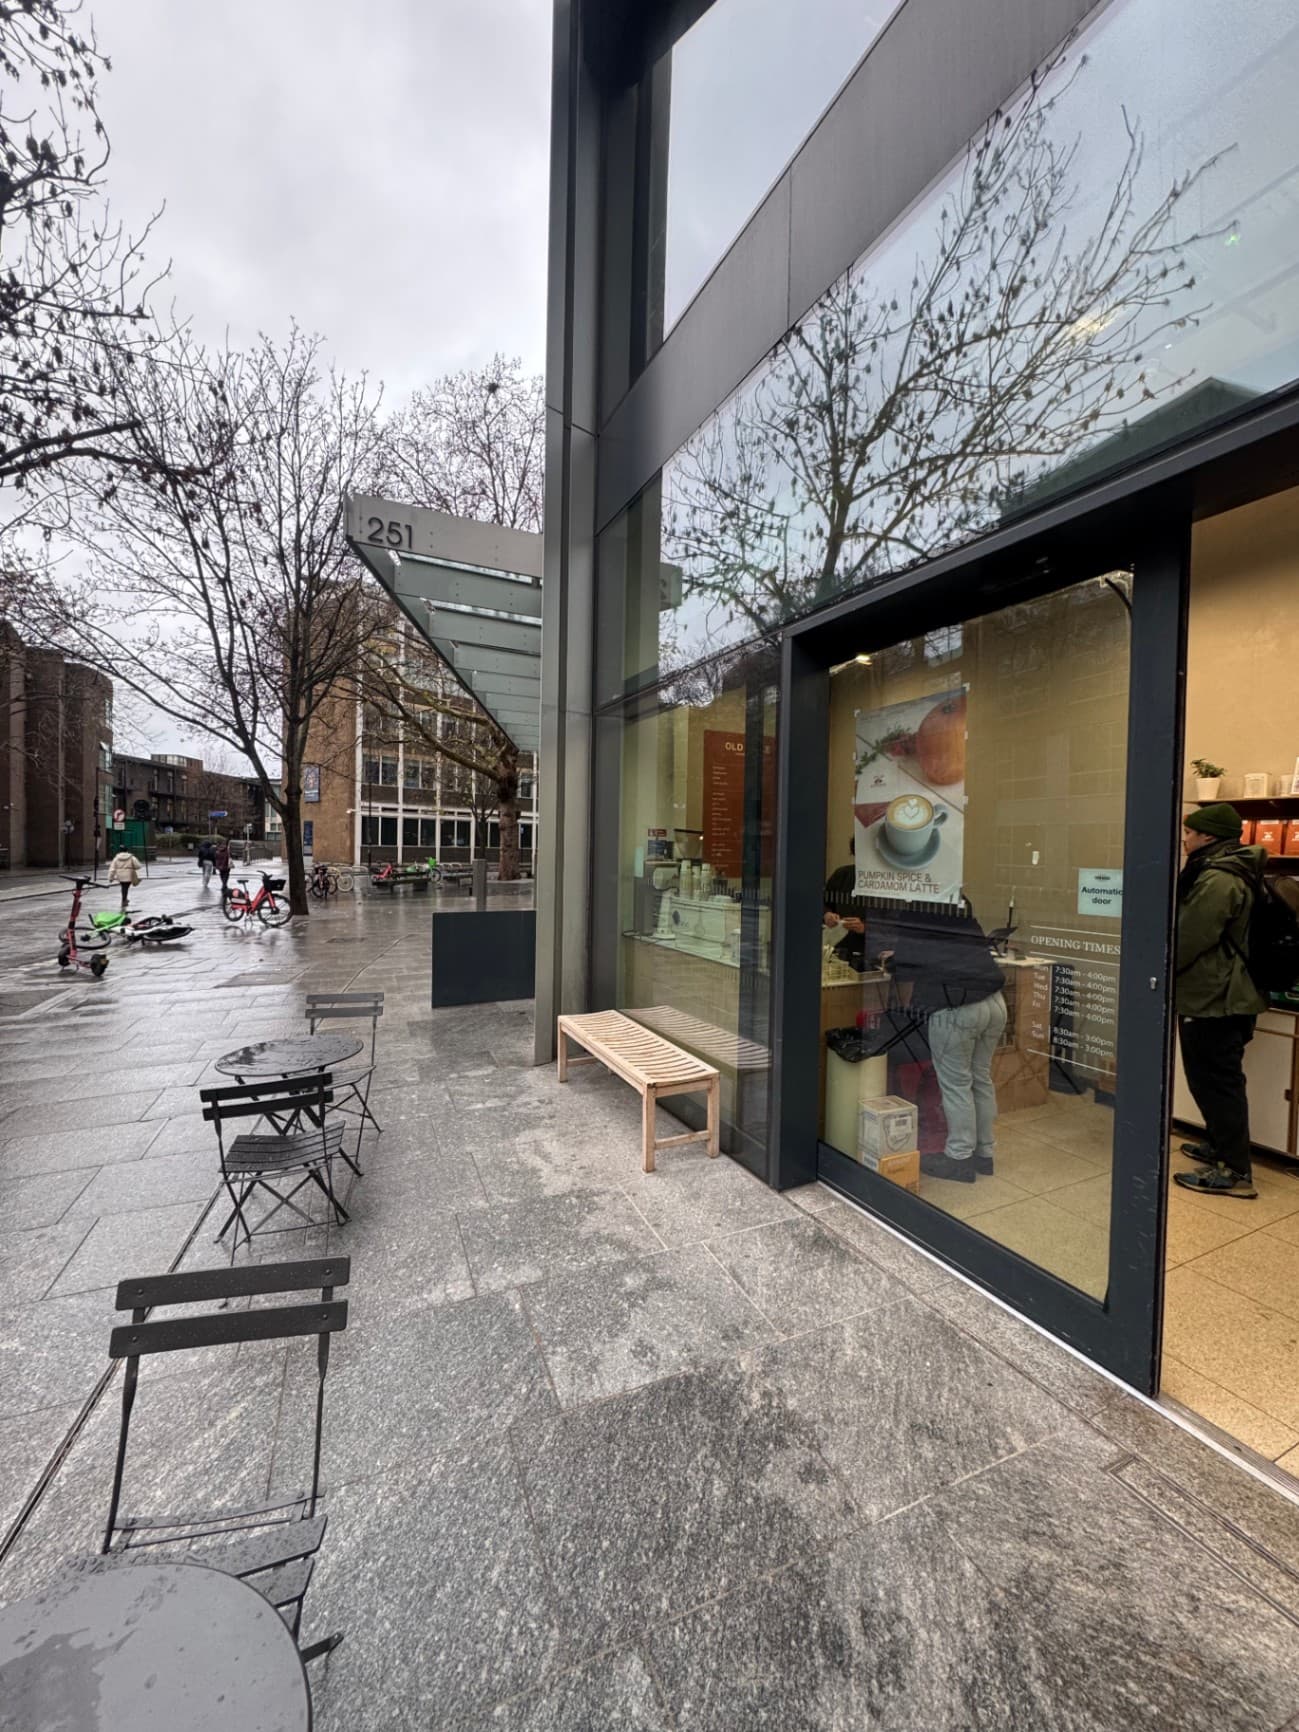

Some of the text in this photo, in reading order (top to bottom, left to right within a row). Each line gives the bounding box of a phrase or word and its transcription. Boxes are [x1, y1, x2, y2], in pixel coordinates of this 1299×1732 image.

[367, 516, 413, 549] 251
[725, 742, 744, 752] OLD
[858, 870, 932, 882] PUMPKIN SPICE &
[858, 880, 940, 894] CARDAMOM LATTE
[1081, 886, 1126, 896] Automatic
[1030, 935, 1120, 955] OPENING TIMES
